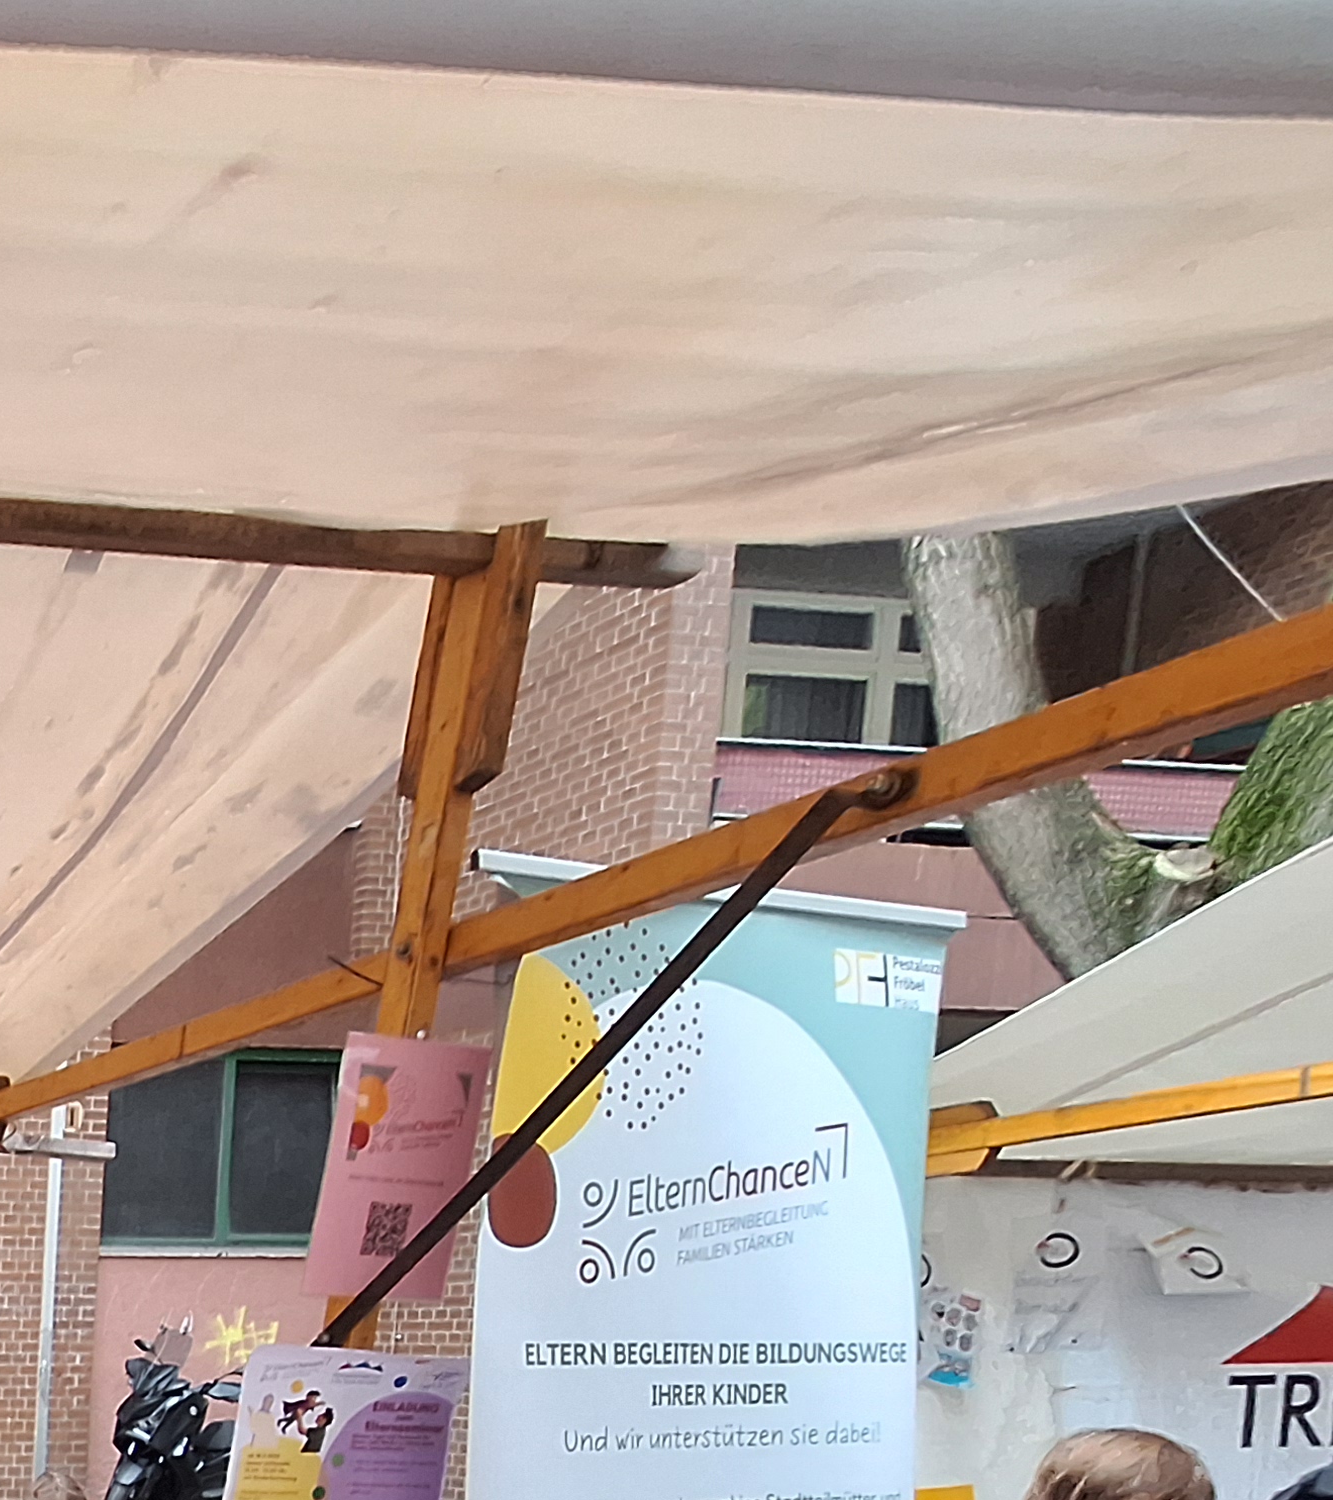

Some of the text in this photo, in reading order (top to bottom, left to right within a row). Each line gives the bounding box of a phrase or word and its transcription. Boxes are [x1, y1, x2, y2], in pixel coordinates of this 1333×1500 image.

[629, 1149, 830, 1216] ElternChanceN
[526, 1343, 906, 1365] ELTERN BEGLEITEN DIE BILDUNGSWEGE
[652, 1383, 788, 1406] IHRER KINDER
[1228, 1374, 1333, 1448] TR
[565, 1426, 608, 1452] Und
[616, 1428, 643, 1450] wir
[650, 1424, 783, 1449] unterstützen
[790, 1424, 819, 1446] sie
